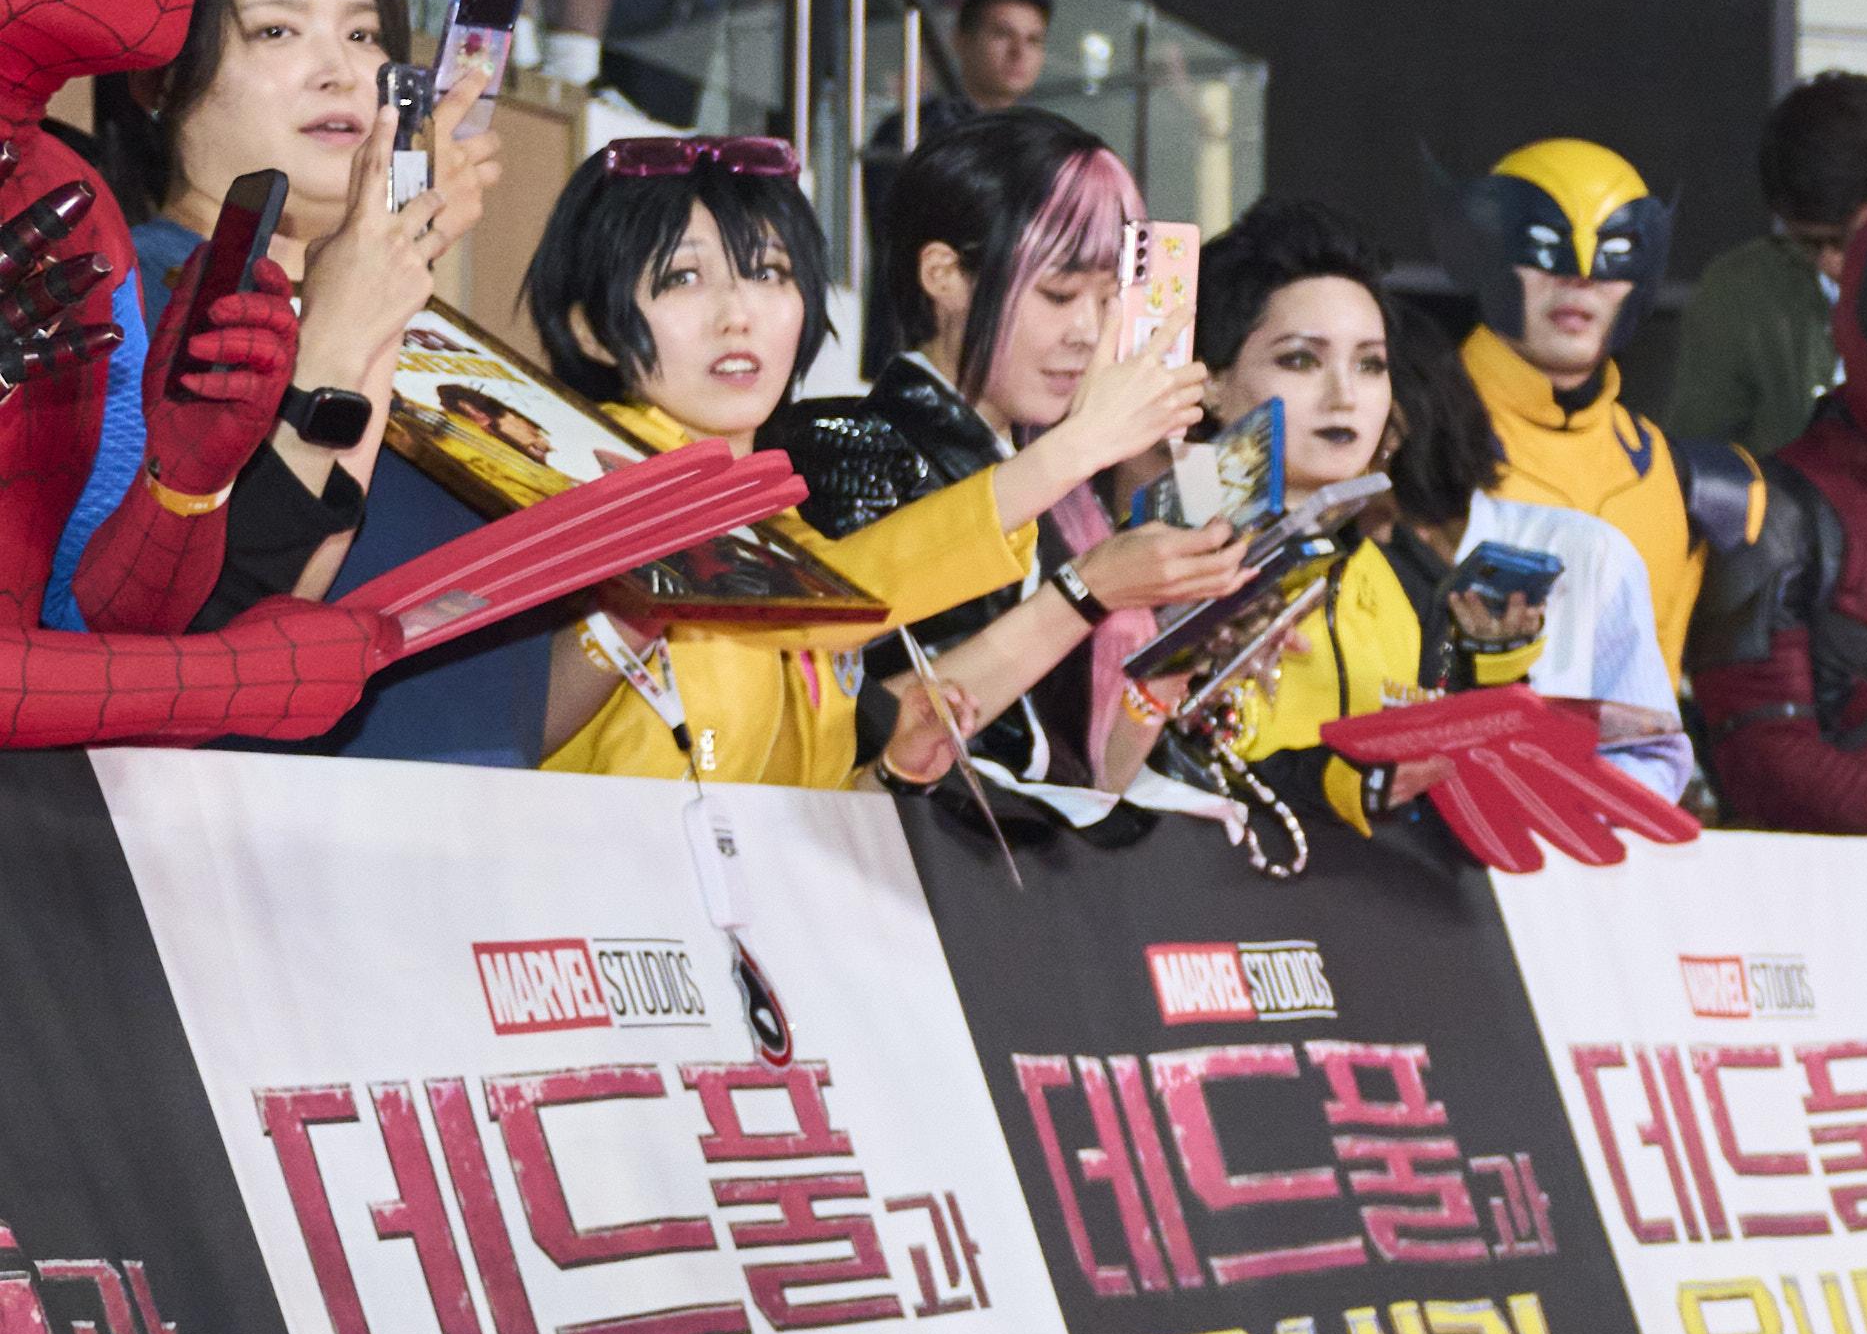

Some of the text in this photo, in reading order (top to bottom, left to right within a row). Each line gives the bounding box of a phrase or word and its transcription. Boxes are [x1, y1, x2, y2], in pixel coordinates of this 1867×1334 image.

[474, 944, 707, 1029] MARVEL STUDIOS
[1153, 946, 1335, 1019] MARVEL STUDIOS
[1750, 961, 1817, 1013] STUDIOS
[1012, 1040, 1558, 1297] 데드풀과
